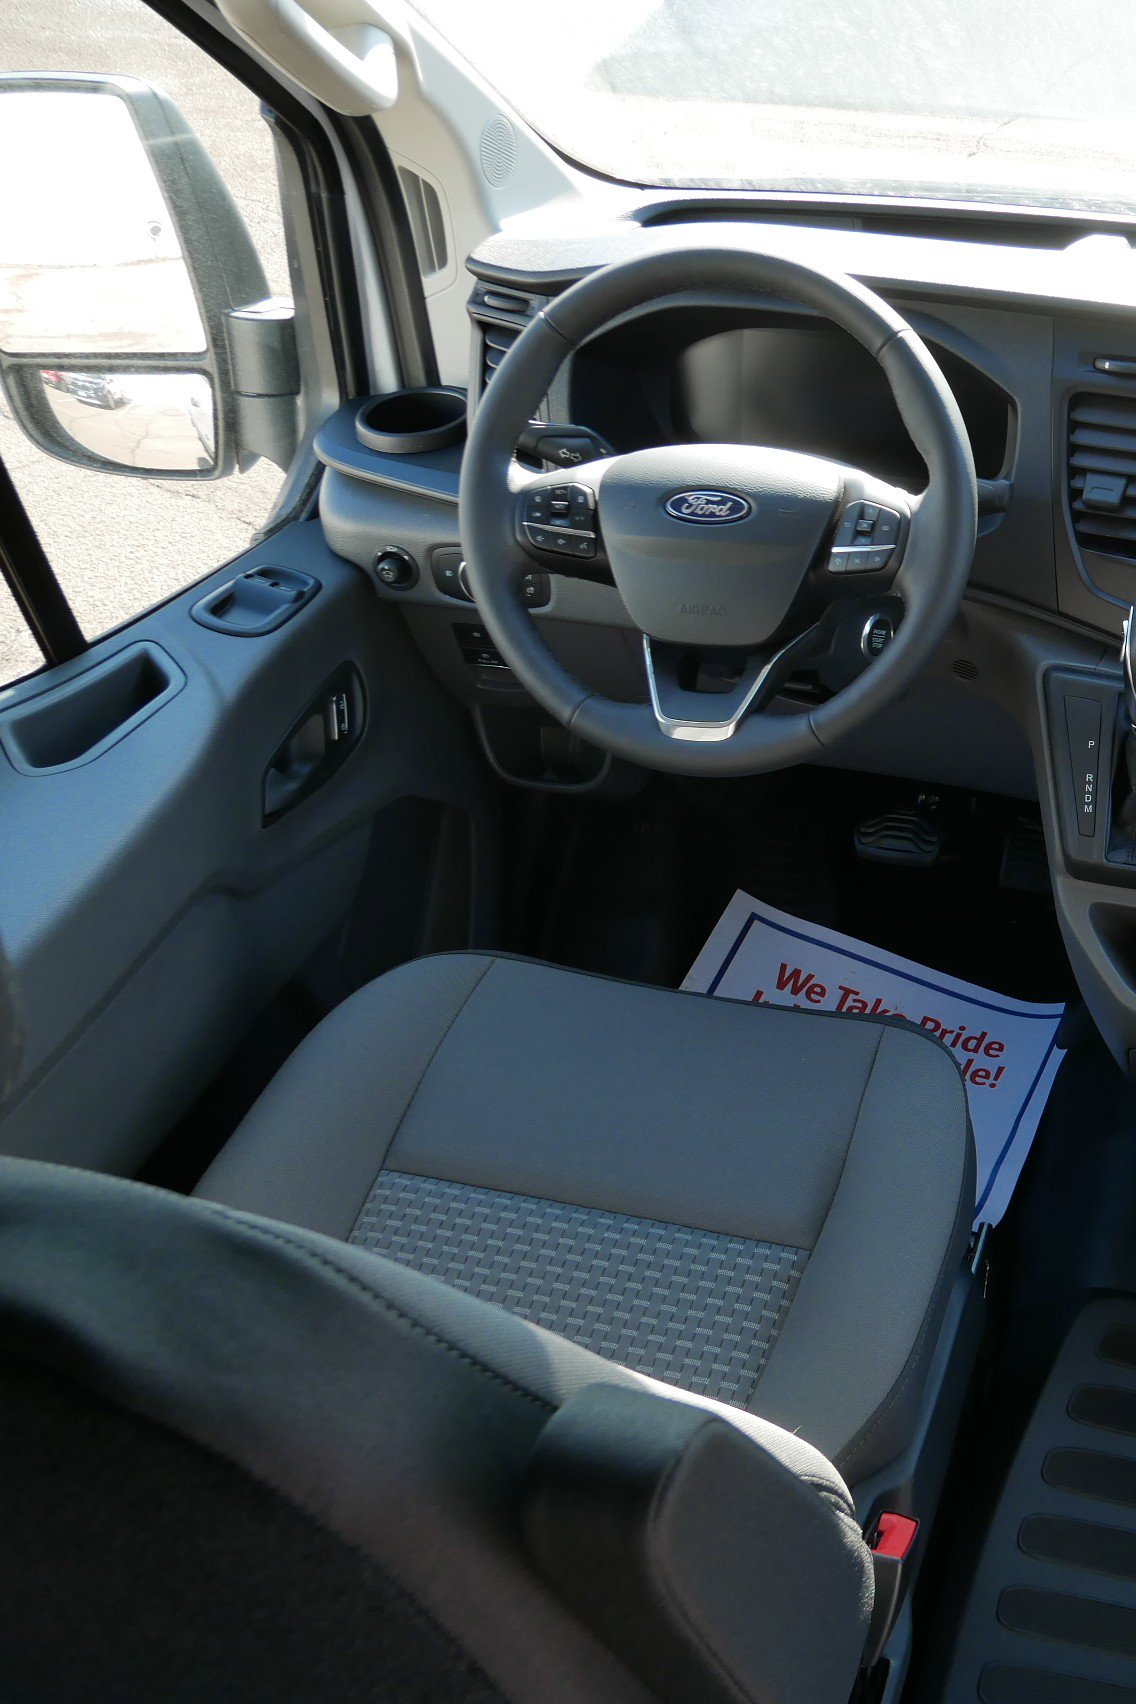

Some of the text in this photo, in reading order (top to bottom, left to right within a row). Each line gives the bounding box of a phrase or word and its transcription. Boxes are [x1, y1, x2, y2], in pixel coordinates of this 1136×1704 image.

[681, 494, 733, 516] Ford
[1088, 740, 1095, 748] P
[1085, 773, 1093, 782] R
[1085, 784, 1093, 792] N
[1084, 794, 1092, 802] D
[1084, 804, 1093, 813] M
[775, 962, 1005, 1059] We Tak Pride
